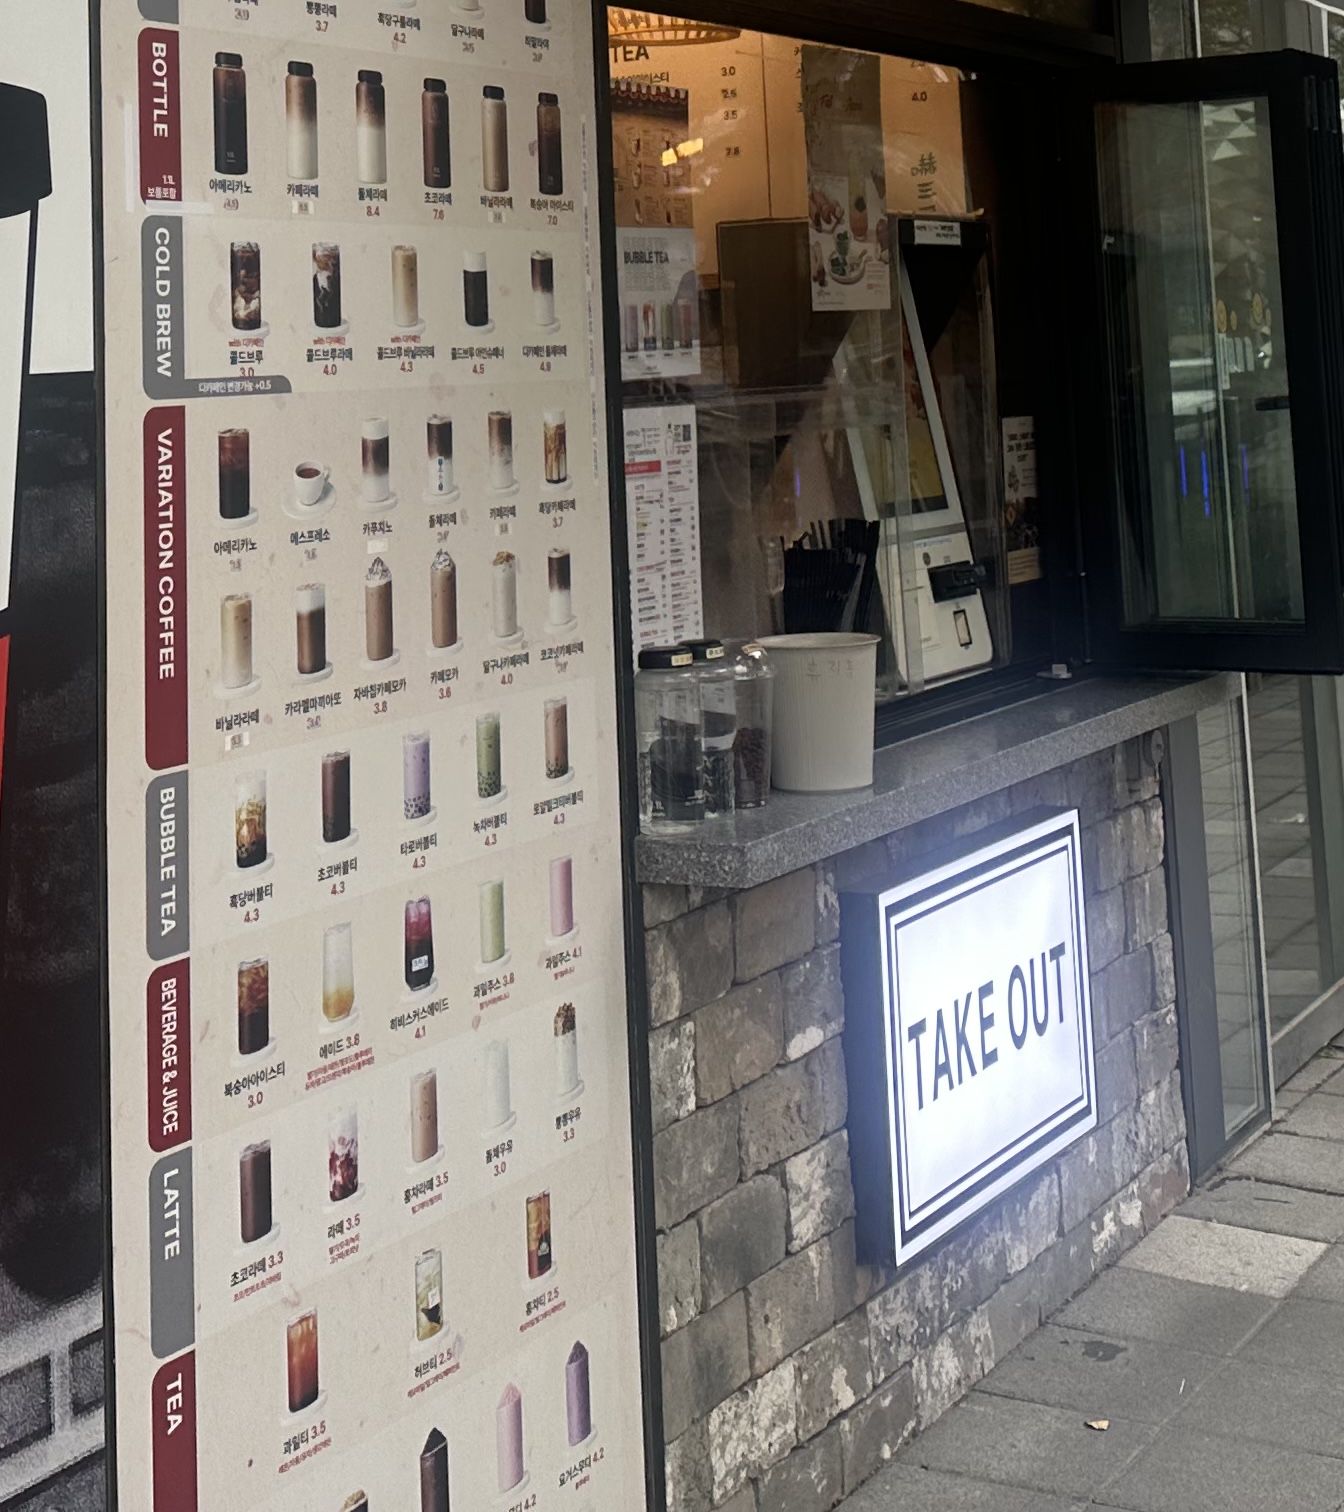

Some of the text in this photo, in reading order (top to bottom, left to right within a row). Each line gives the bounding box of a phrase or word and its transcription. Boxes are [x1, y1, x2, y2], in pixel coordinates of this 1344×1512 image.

[151, 41, 169, 139] BOTTLE
[209, 178, 253, 194] 아메리카노
[286, 183, 319, 198] 카페라떼
[424, 191, 453, 206] 초코라떼
[480, 195, 514, 210] 바닐라라떼
[654, 251, 669, 264] TEA
[154, 226, 172, 379] COLD BREW
[229, 349, 263, 365] 콜드브루
[306, 347, 353, 363] 콜드브루라떼
[377, 345, 403, 361] 콜드브루
[322, 363, 338, 376] 4.0
[254, 379, 272, 391] +0.5
[290, 527, 331, 546] 에스프레소
[362, 520, 394, 536] 카푸치노
[156, 426, 175, 680] VARIATION COFFEE
[213, 537, 258, 556] 아메리카노
[430, 666, 460, 685] 카페모카
[500, 673, 514, 686] 4.0
[353, 678, 407, 701] 자바칩카페모카
[214, 708, 260, 732] 바닐라라떼
[473, 812, 508, 834] 녹차버블티
[553, 812, 566, 825] 4.3
[400, 832, 438, 857] 타로버블티
[484, 833, 498, 847] 4.3
[159, 786, 177, 937] BUBBLE TEA
[317, 856, 358, 882] 초코버블티
[412, 855, 427, 869] 4.3
[229, 882, 274, 909] 흑당버블티
[330, 880, 346, 896] 4.3
[243, 907, 260, 923] 4.3
[389, 997, 450, 1031] 히비스커스에이드
[908, 941, 1066, 1111] TAKE OUT
[161, 977, 179, 1135] BEVERAGE JUICE
[319, 1038, 344, 1060] 에이드
[223, 1060, 286, 1098] 복숭아아이스티
[247, 1091, 264, 1108] 3.0
[493, 1160, 507, 1177] 3.0
[435, 1170, 449, 1188] 3.5
[162, 1167, 181, 1261] LATTE
[327, 1212, 361, 1239] 라떼 3.5
[230, 1256, 267, 1288] 초코라떼
[267, 1249, 284, 1269] 3.3
[414, 1354, 438, 1379] 허브티
[165, 1373, 183, 1436] TEA
[282, 1428, 309, 1456] 과일티
[310, 1419, 327, 1440] 3.5
